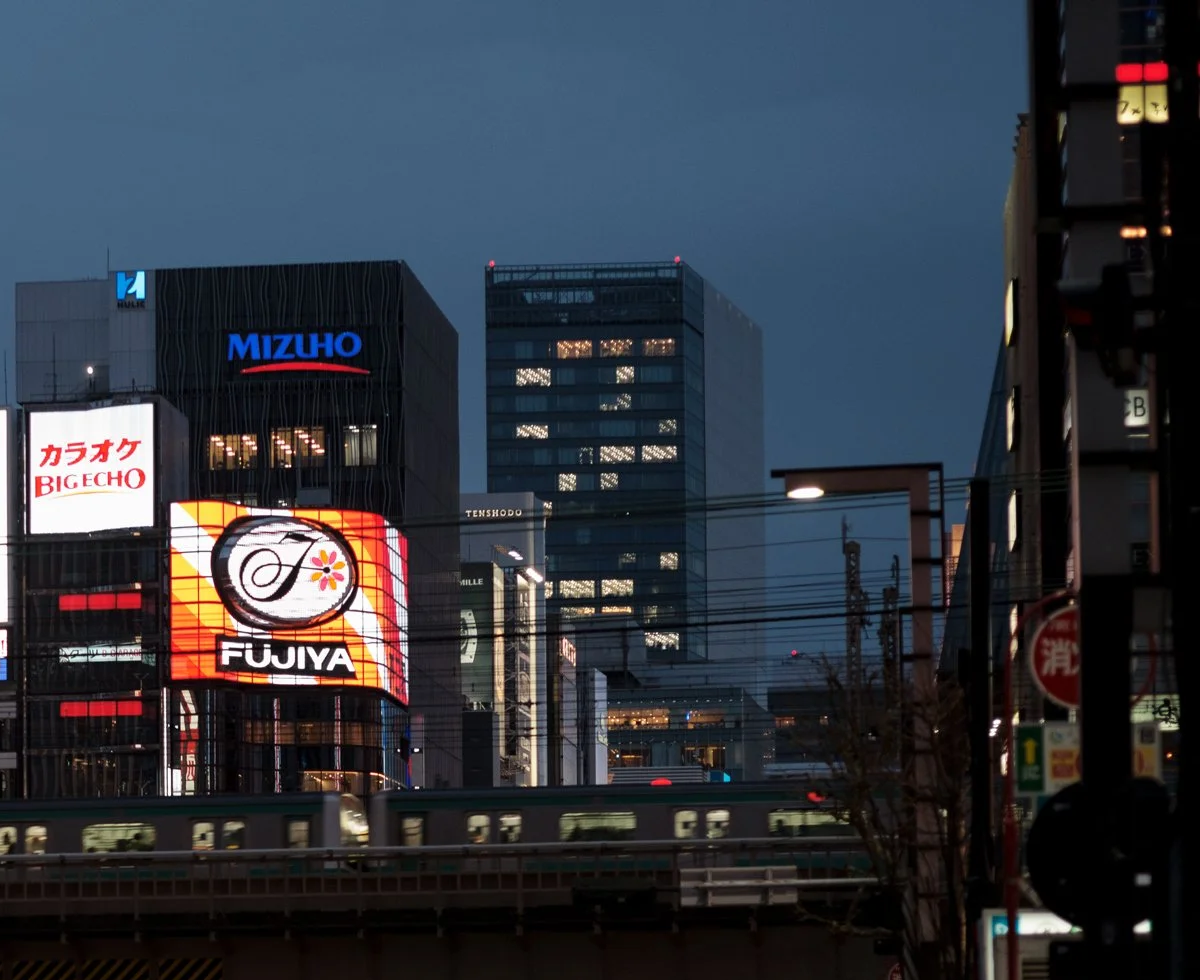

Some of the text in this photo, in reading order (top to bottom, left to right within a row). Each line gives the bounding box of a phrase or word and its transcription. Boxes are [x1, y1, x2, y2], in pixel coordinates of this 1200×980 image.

[227, 332, 362, 361] MIZUHO
[40, 438, 141, 468] カラオケ
[34, 468, 146, 498] BIG ECHO
[465, 508, 522, 518] TENSHODO
[221, 641, 355, 672] FUJIYA
